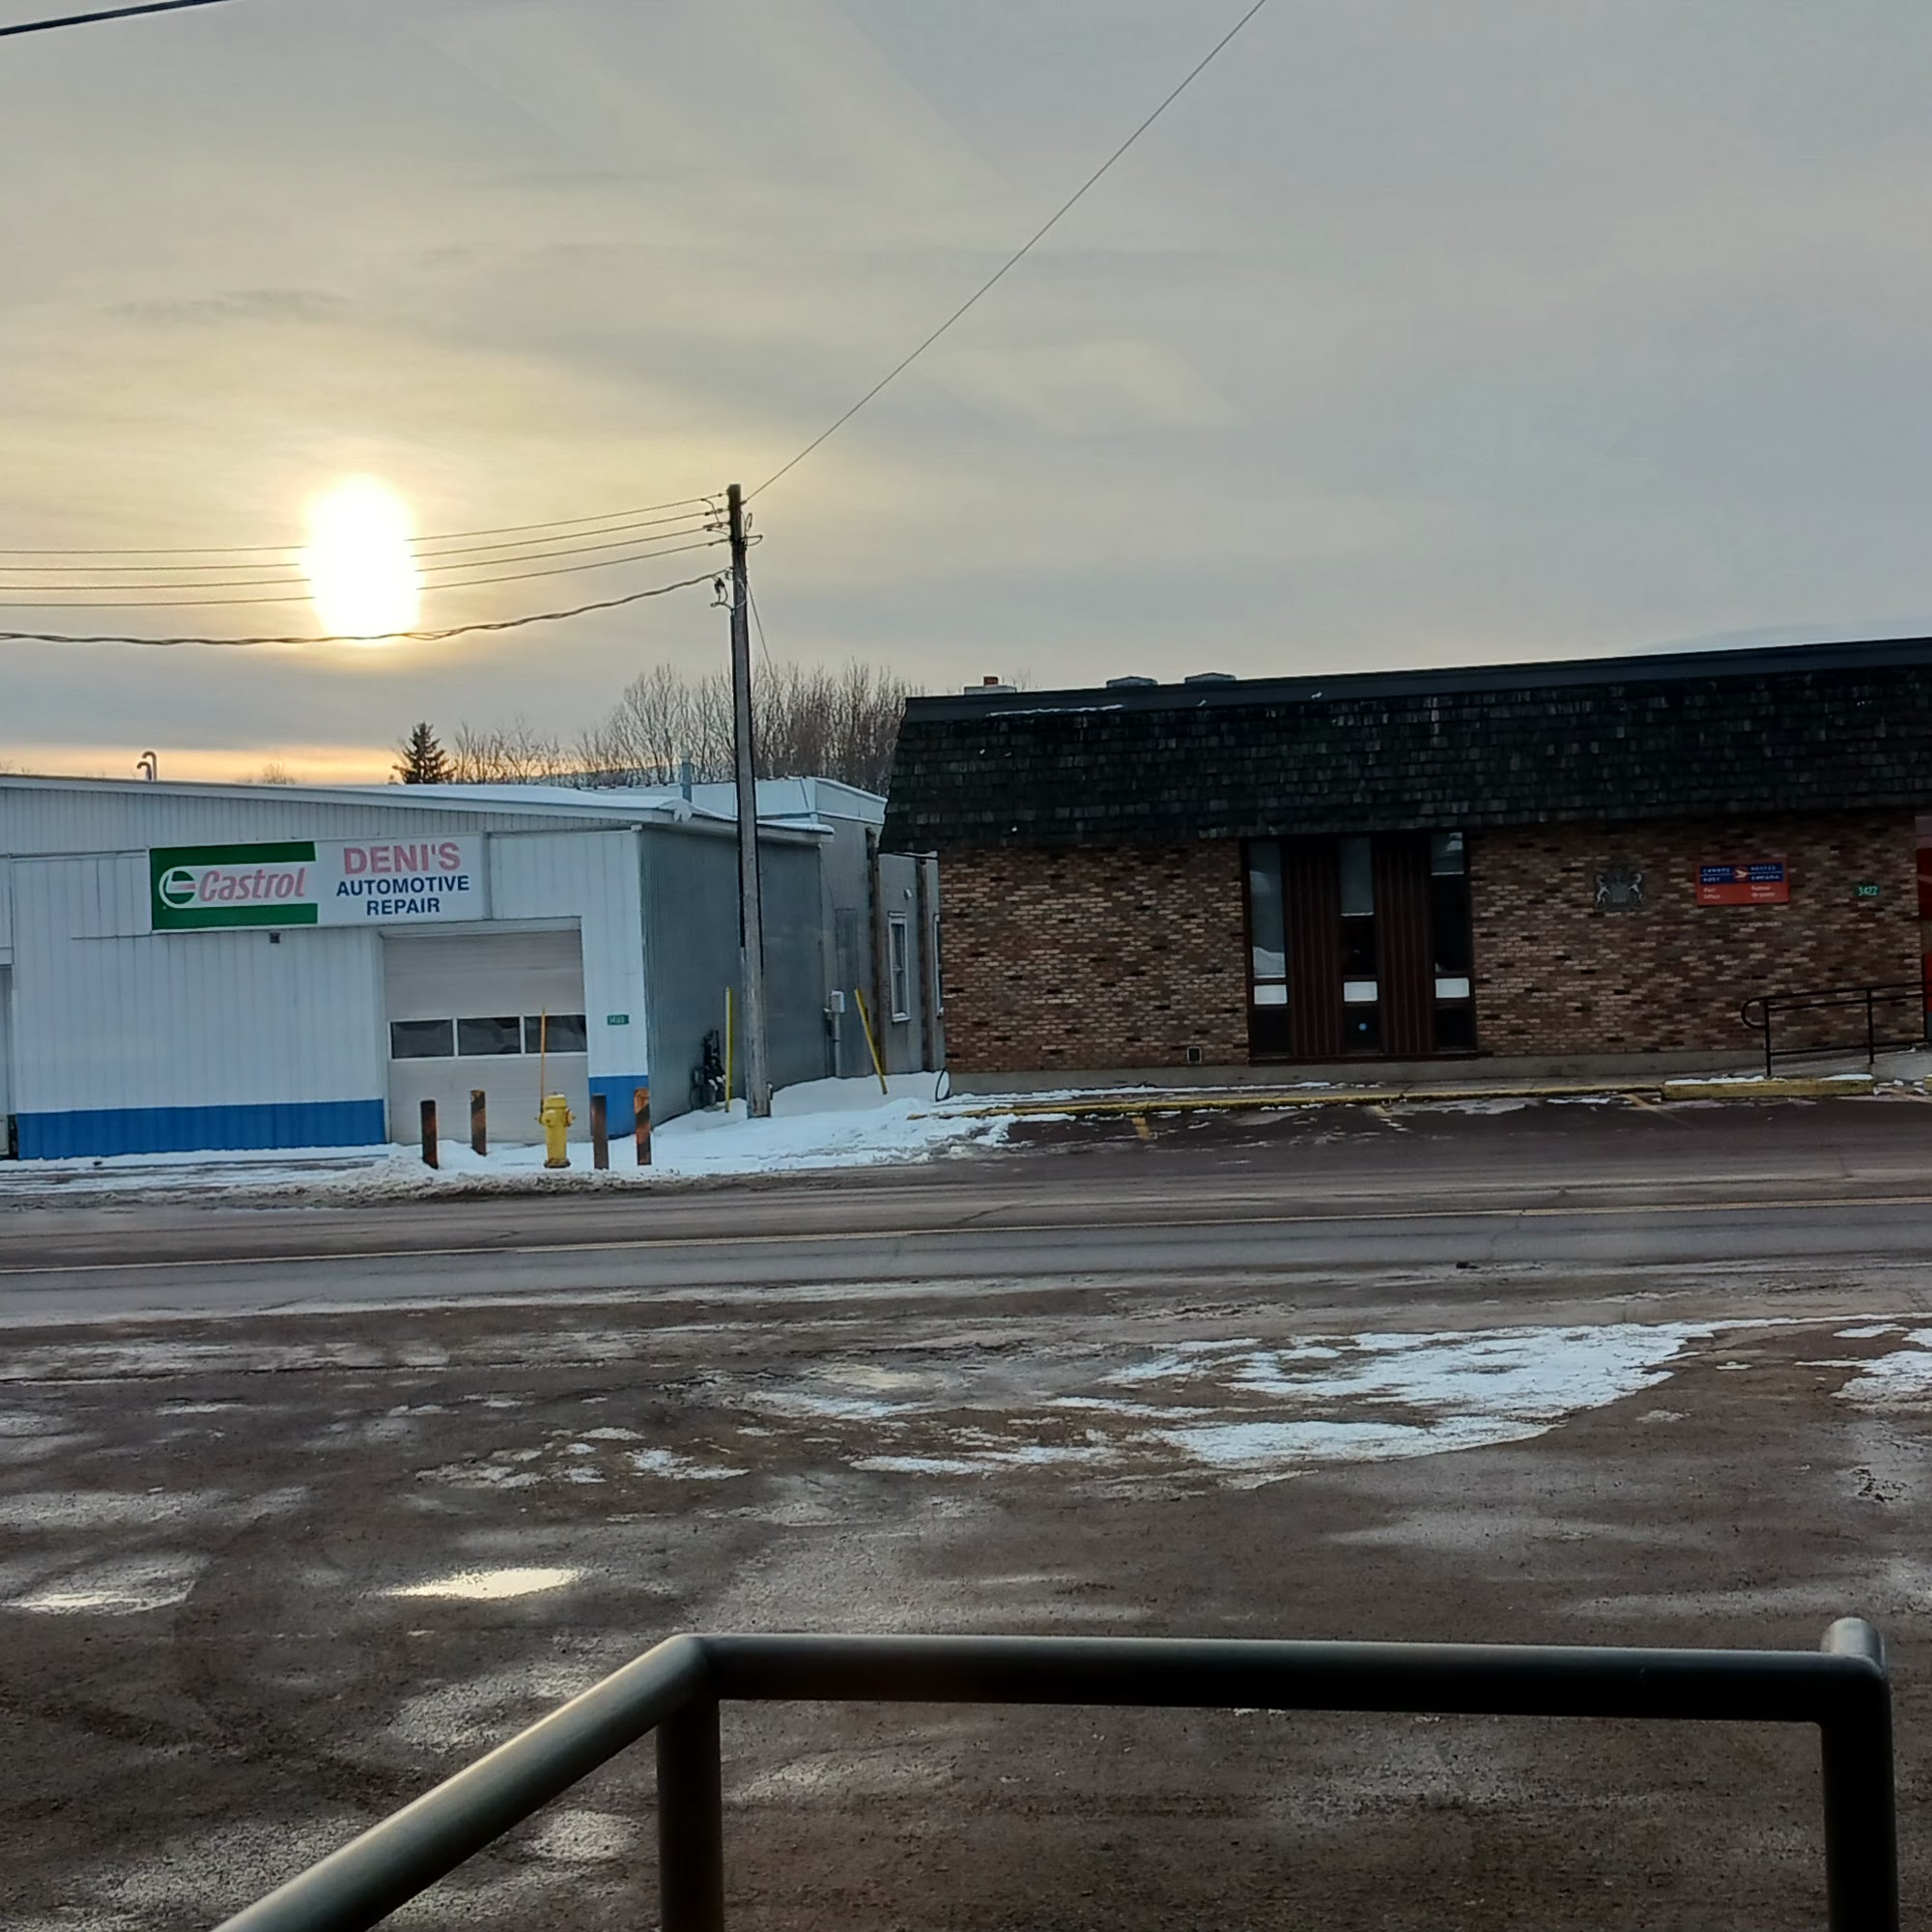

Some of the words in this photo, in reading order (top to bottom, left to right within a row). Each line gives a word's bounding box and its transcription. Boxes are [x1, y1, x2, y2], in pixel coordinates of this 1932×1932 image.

[343, 841, 461, 875] DENI'S
[198, 867, 305, 902] Castrol
[336, 874, 469, 896] AUTOMOTIVE
[366, 897, 440, 916] REPAIR
